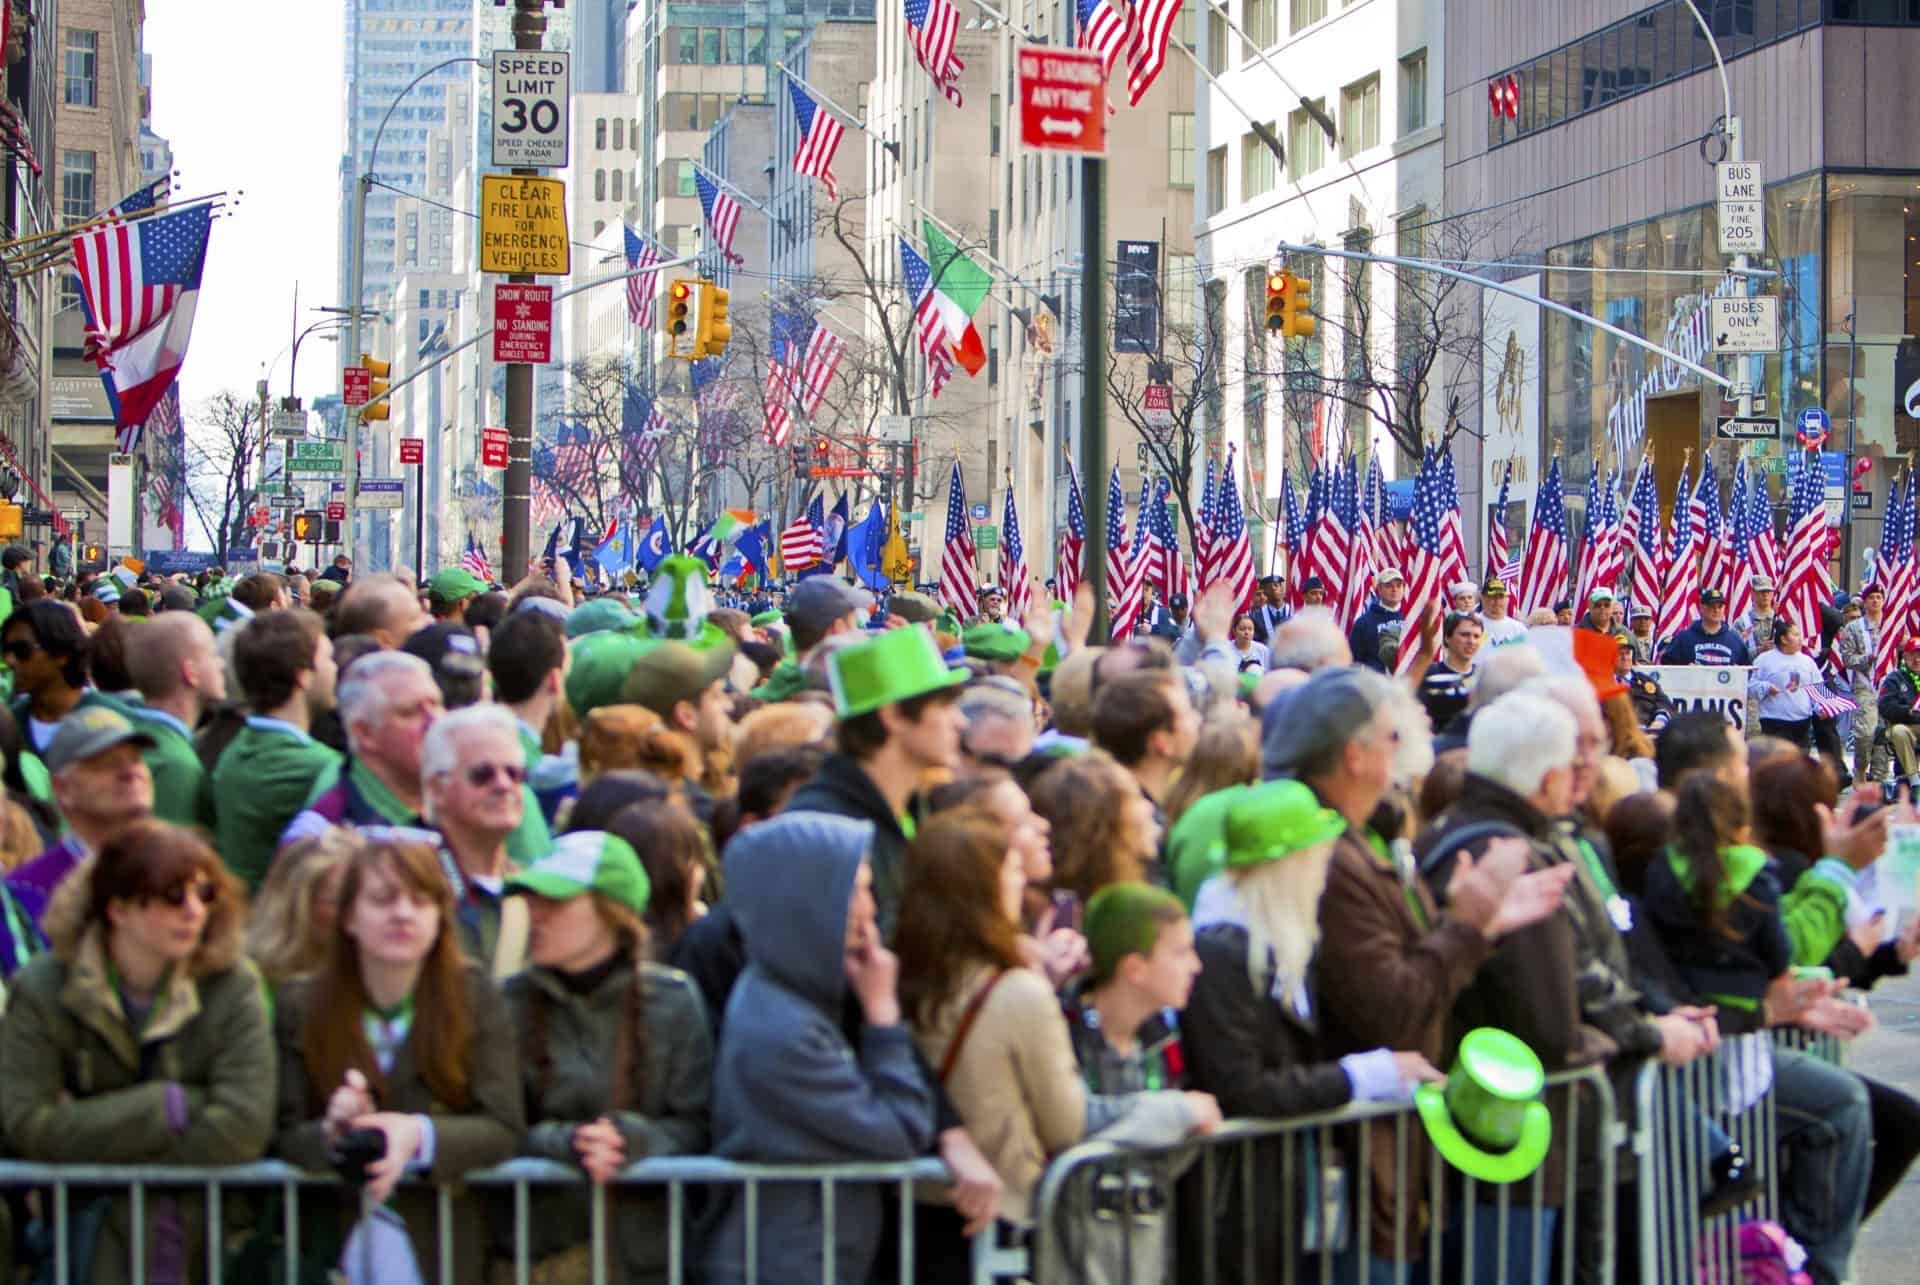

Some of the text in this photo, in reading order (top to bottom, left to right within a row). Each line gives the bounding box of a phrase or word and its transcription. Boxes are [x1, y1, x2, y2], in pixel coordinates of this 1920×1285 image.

[499, 60, 563, 75] SPEED
[1022, 57, 1102, 86] NO STANDING
[506, 79, 556, 95] LIMIT
[1031, 86, 1092, 113] ANYTIME
[501, 98, 559, 134] 30
[497, 138, 564, 148] SPEED CHECKED
[508, 149, 552, 158] BY RADAR
[1728, 168, 1752, 180] BUS
[500, 185, 552, 200] CLEAR
[1725, 184, 1756, 197] LANE
[491, 202, 560, 220] FIRE LANE
[1727, 205, 1745, 213] TOW
[1731, 215, 1753, 224] FINE
[514, 221, 535, 232] FOR
[485, 232, 564, 250] EMERGENCY
[1127, 245, 1150, 254] NYC
[492, 250, 559, 267] VEHICLES
[498, 289, 550, 303] SNOW ROUTE
[1723, 302, 1765, 313] BUSES
[496, 320, 549, 332] NO STANDING
[1728, 316, 1760, 328] ONLY
[500, 341, 544, 350] EMERGENCY
[1147, 398, 1169, 408] ZONE
[1726, 423, 1772, 433] ONE WAY
[299, 444, 326, 457] E 52
